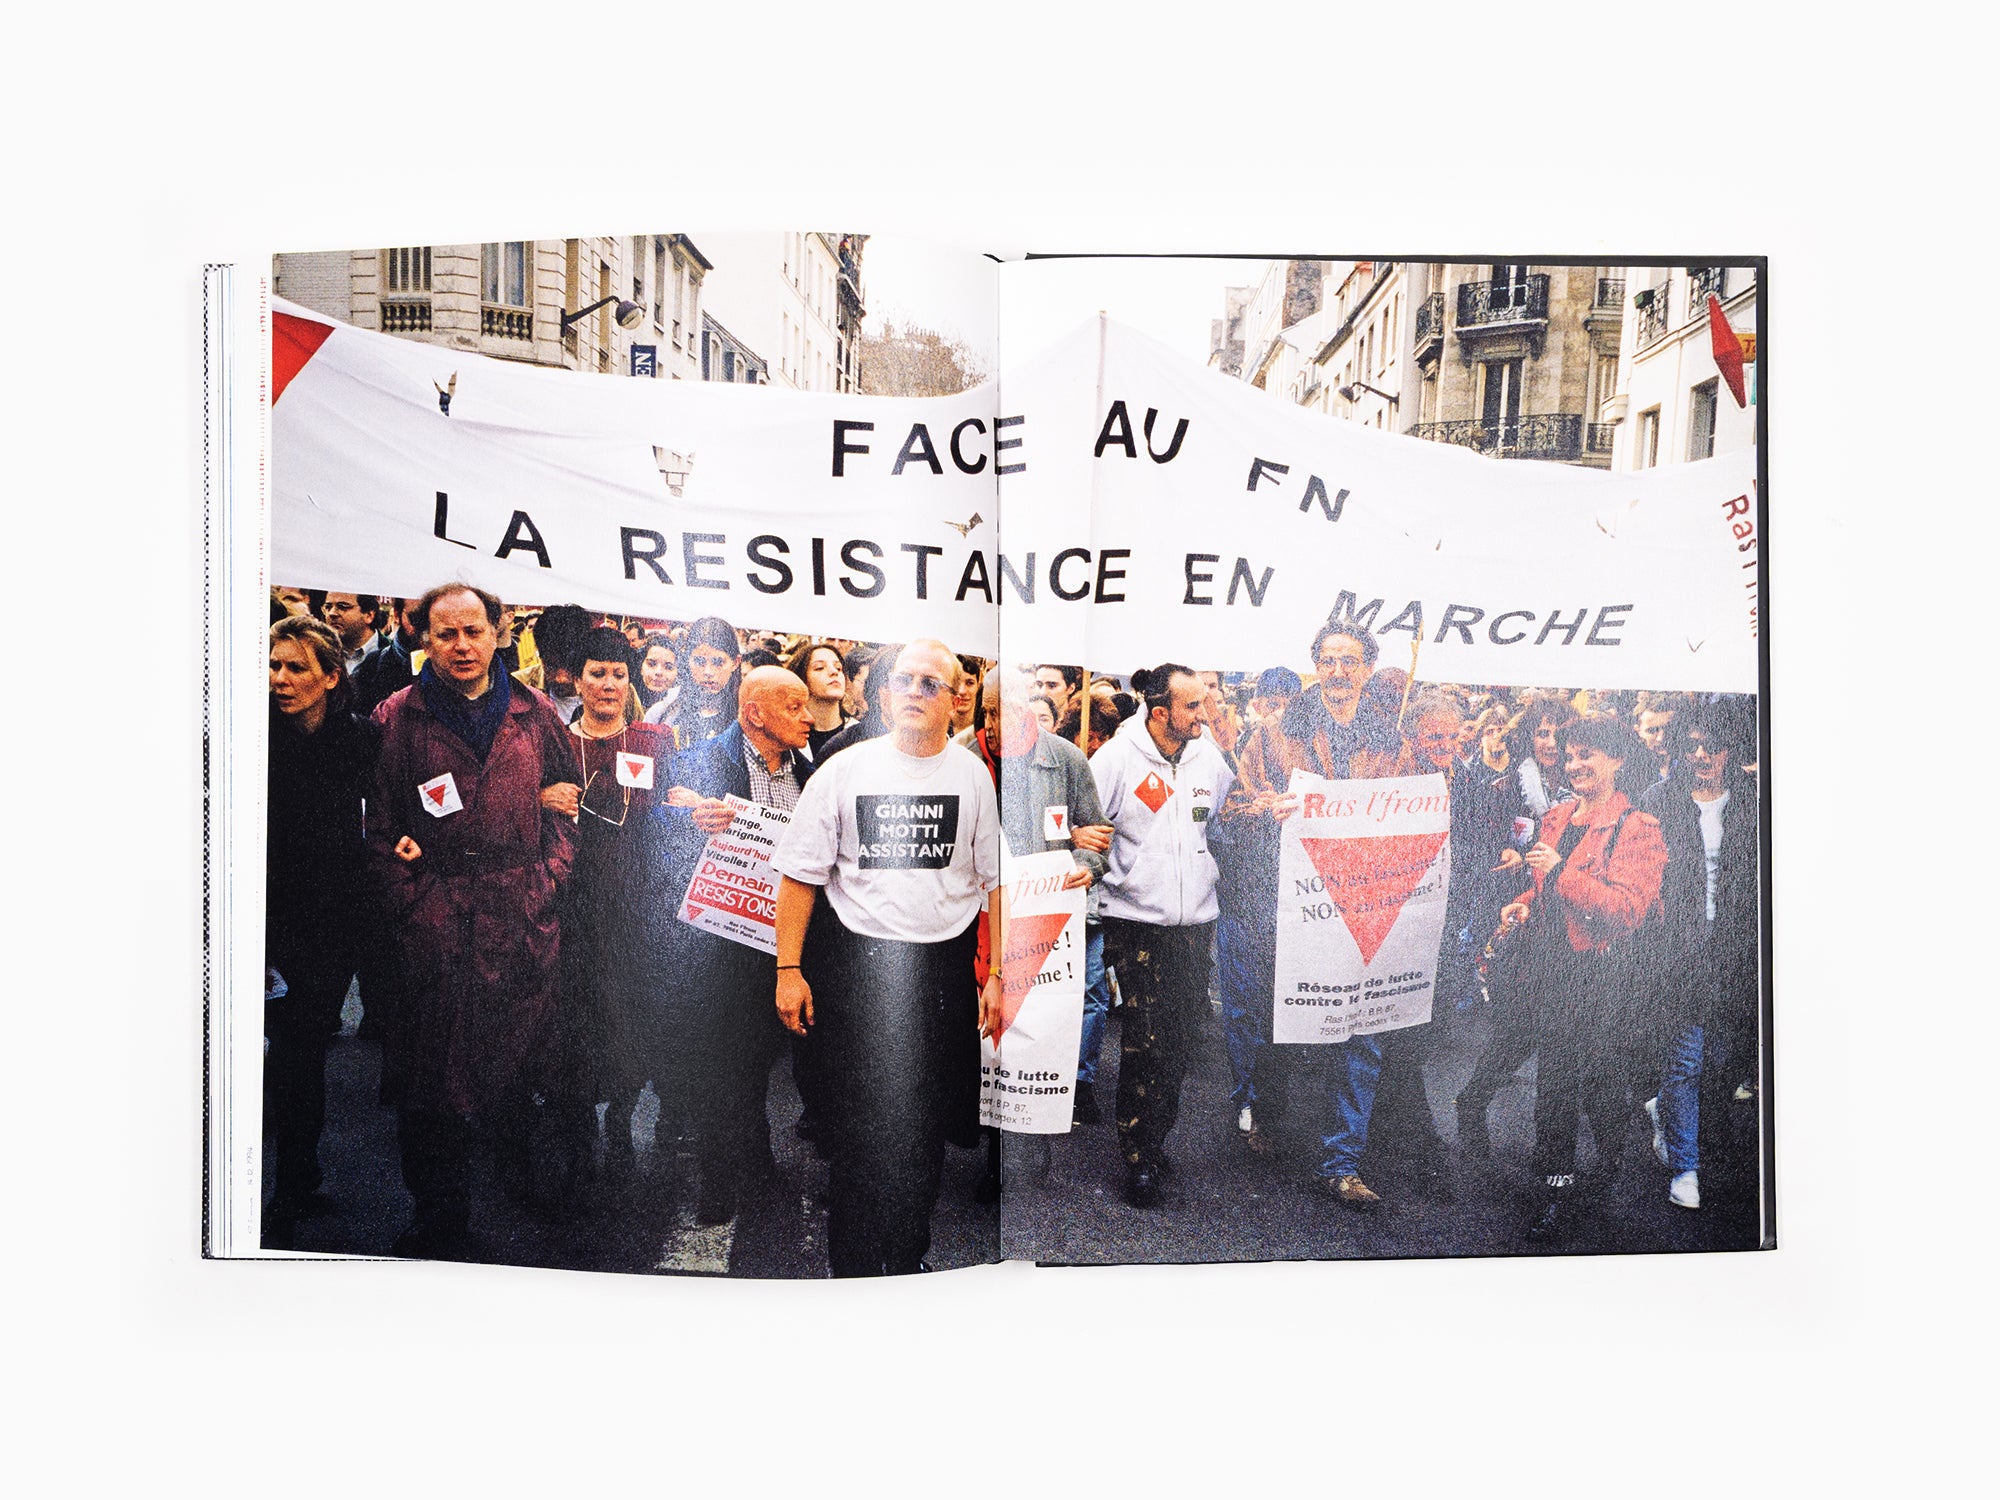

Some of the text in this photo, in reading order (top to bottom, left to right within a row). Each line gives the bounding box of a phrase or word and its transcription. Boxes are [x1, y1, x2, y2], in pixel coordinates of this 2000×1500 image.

[832, 400, 1350, 522] FACE AU FN
[434, 491, 1634, 646] LA RESISTANCE EN MARCHE
[875, 804, 943, 819] GIANNI
[1303, 793, 1356, 818] Ras
[733, 816, 763, 832] ange,
[880, 824, 938, 838] MOTTI
[710, 838, 772, 862] Aujourd'hui
[859, 843, 955, 858] ASSISTANT
[706, 849, 748, 868] Vitrolles
[701, 861, 774, 895] Demain
[1003, 938, 1060, 964] ascisme
[1364, 978, 1384, 988] de
[1284, 997, 1343, 1007] contre
[1018, 1070, 1060, 1081] lutte
[994, 1079, 1069, 1095] fascisme
